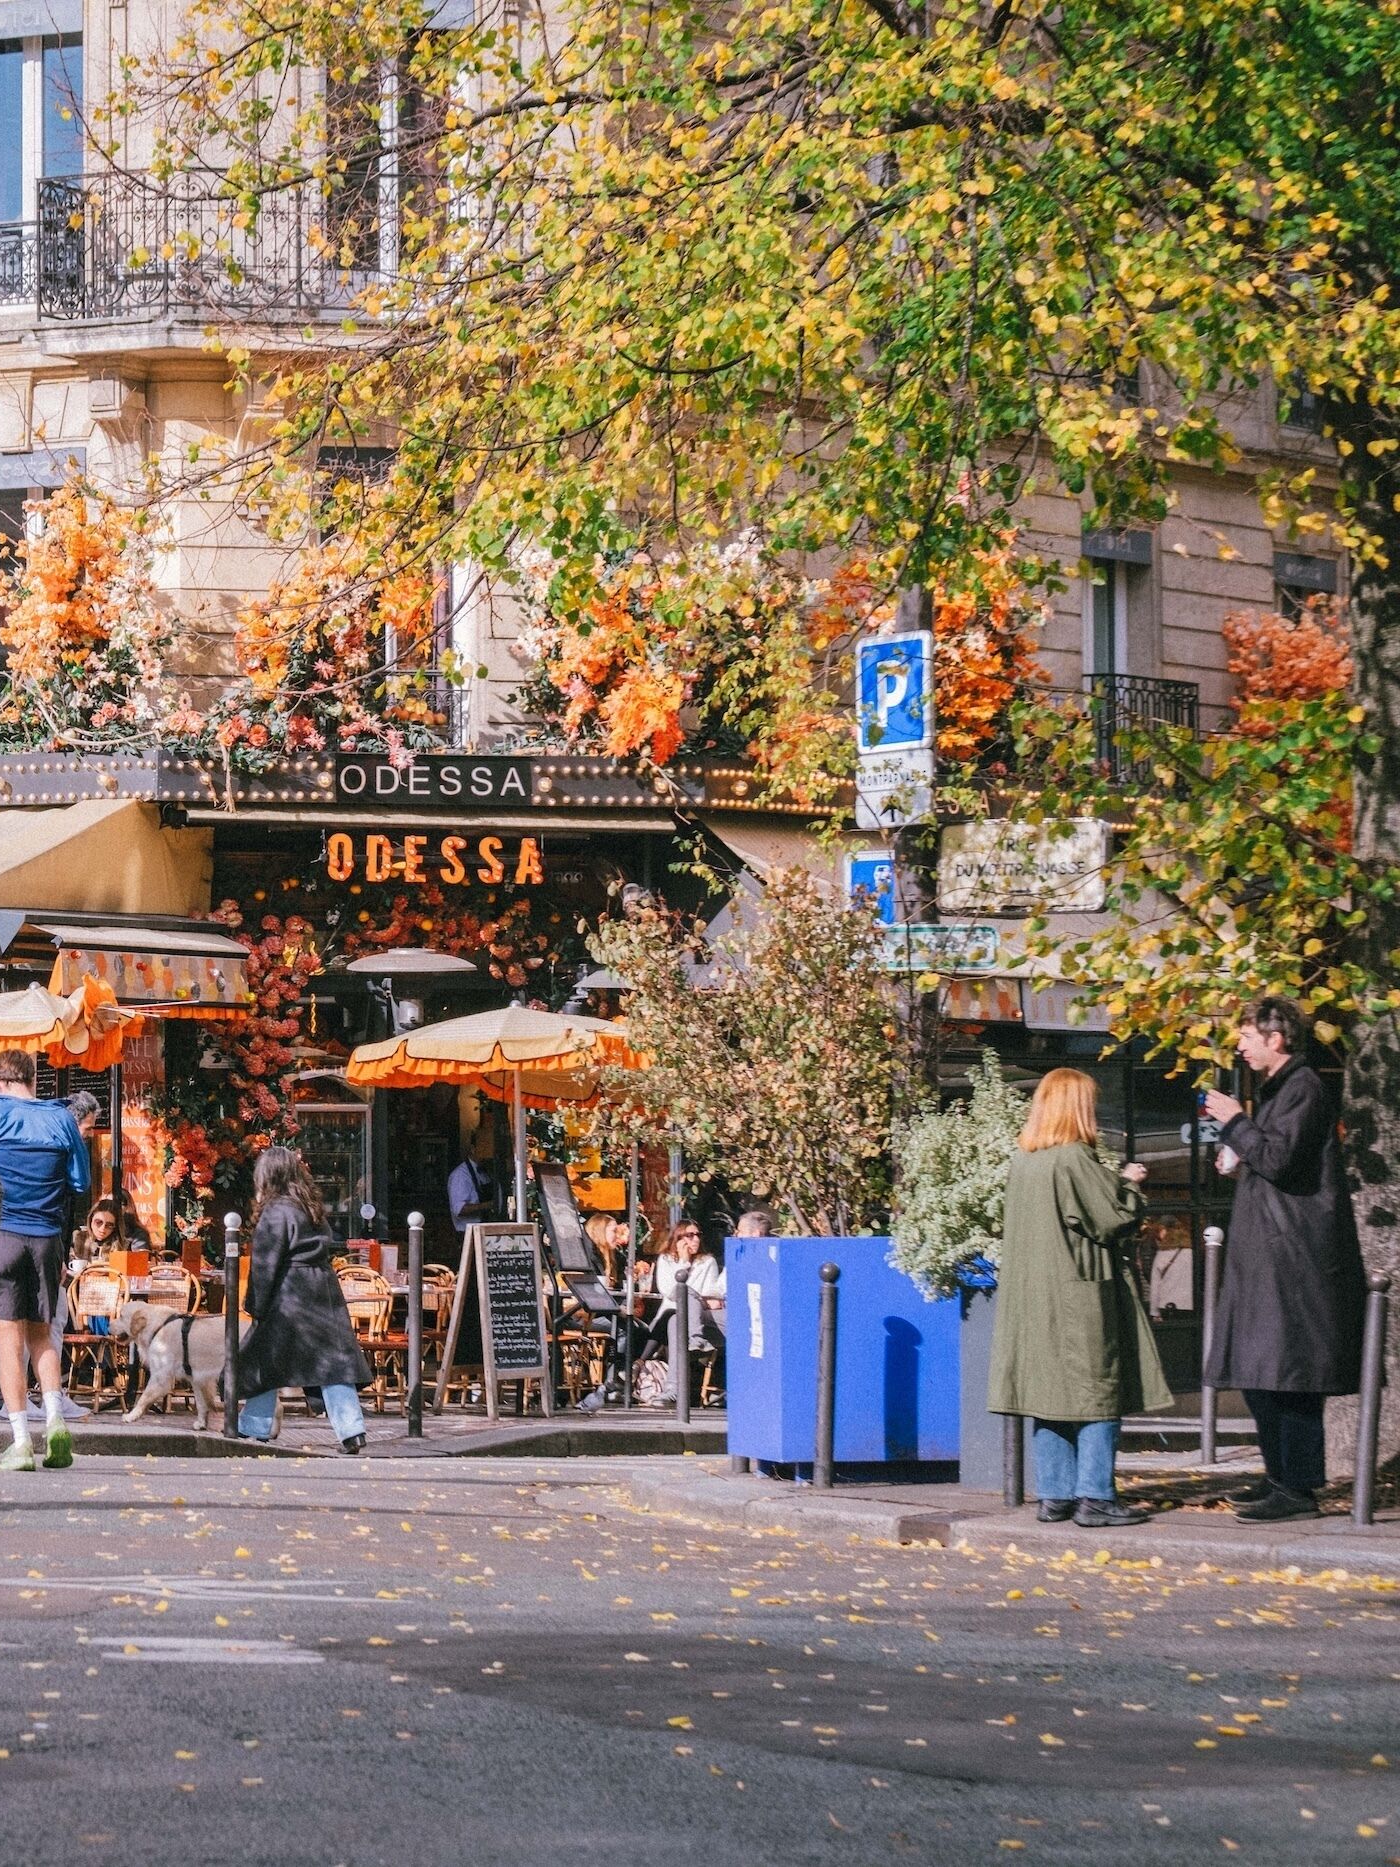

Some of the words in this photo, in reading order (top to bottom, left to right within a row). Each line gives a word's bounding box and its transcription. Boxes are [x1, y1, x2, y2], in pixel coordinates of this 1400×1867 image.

[876, 660, 909, 728] P
[339, 764, 526, 797] ODESSA
[1006, 837, 1036, 852] RE
[327, 832, 544, 885] ODESSA
[956, 863, 974, 877] DU
[126, 1034, 153, 1058] AFE
[122, 1061, 153, 1075] DESSA
